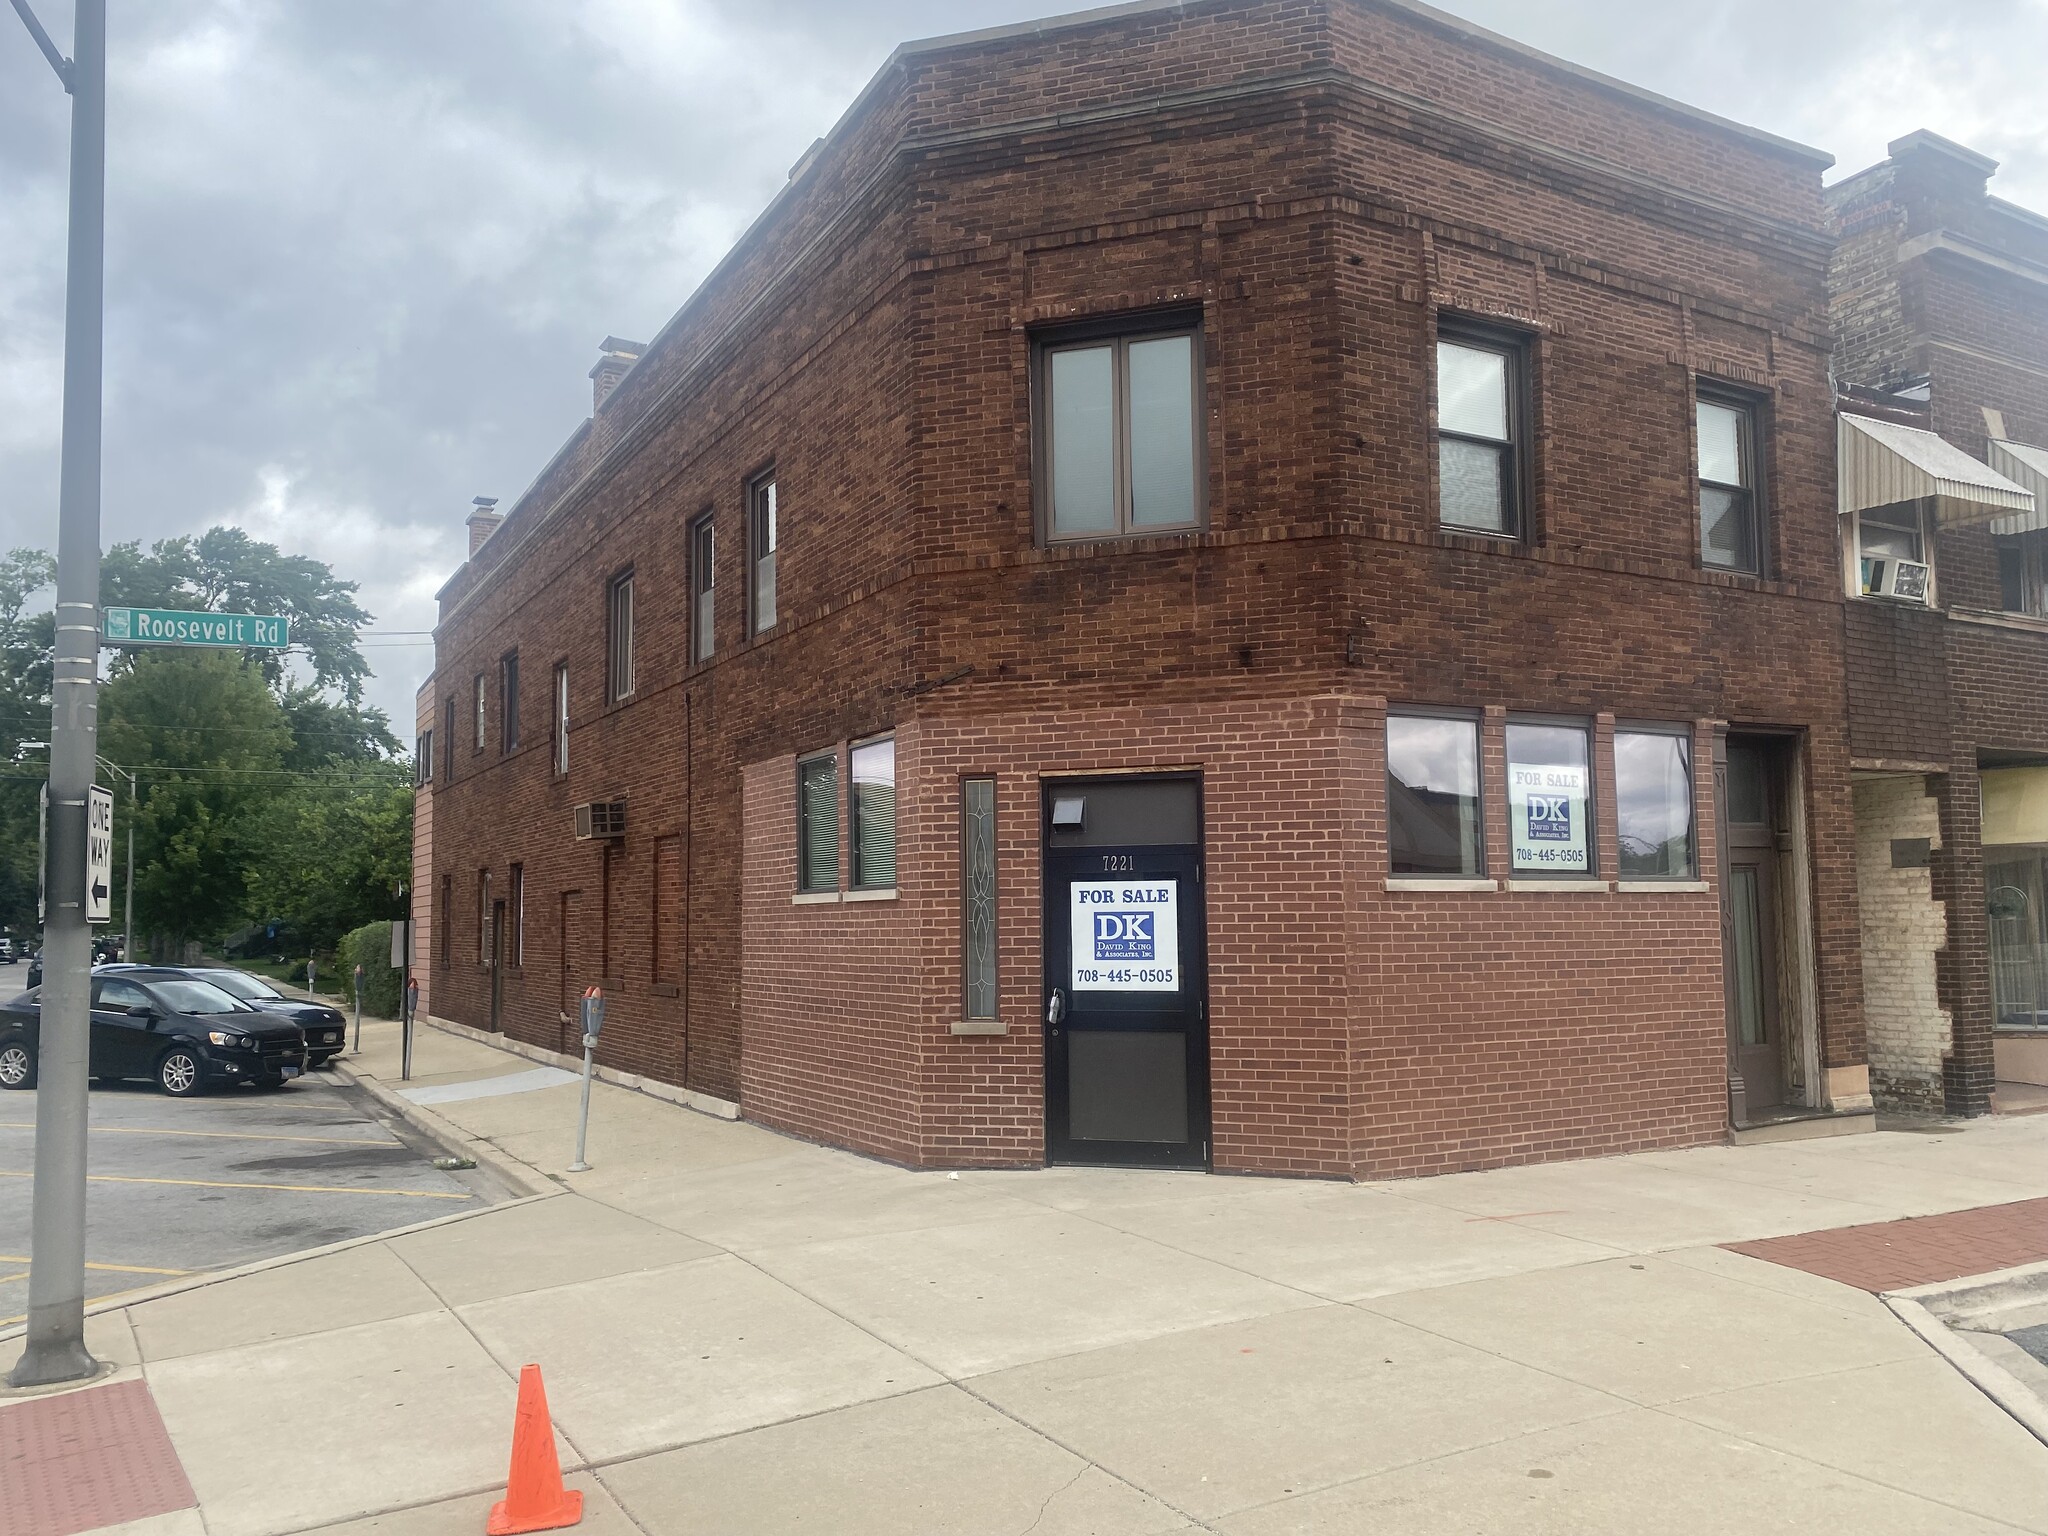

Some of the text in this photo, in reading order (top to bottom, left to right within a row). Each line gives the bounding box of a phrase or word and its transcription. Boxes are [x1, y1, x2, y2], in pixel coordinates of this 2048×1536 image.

[138, 613, 278, 643] Roosevelt Rd
[1516, 772, 1579, 788] FOR SALE
[92, 799, 110, 832] ONE
[1529, 796, 1568, 821] DK
[91, 836, 109, 868] WAY
[1517, 848, 1583, 862] 708-445-0505
[1102, 855, 1134, 871] 7221
[1078, 889, 1169, 904] FOR SALE
[1096, 914, 1152, 940] DK
[1096, 950, 1102, 958] &
[1077, 969, 1173, 983] 708-445-0505
